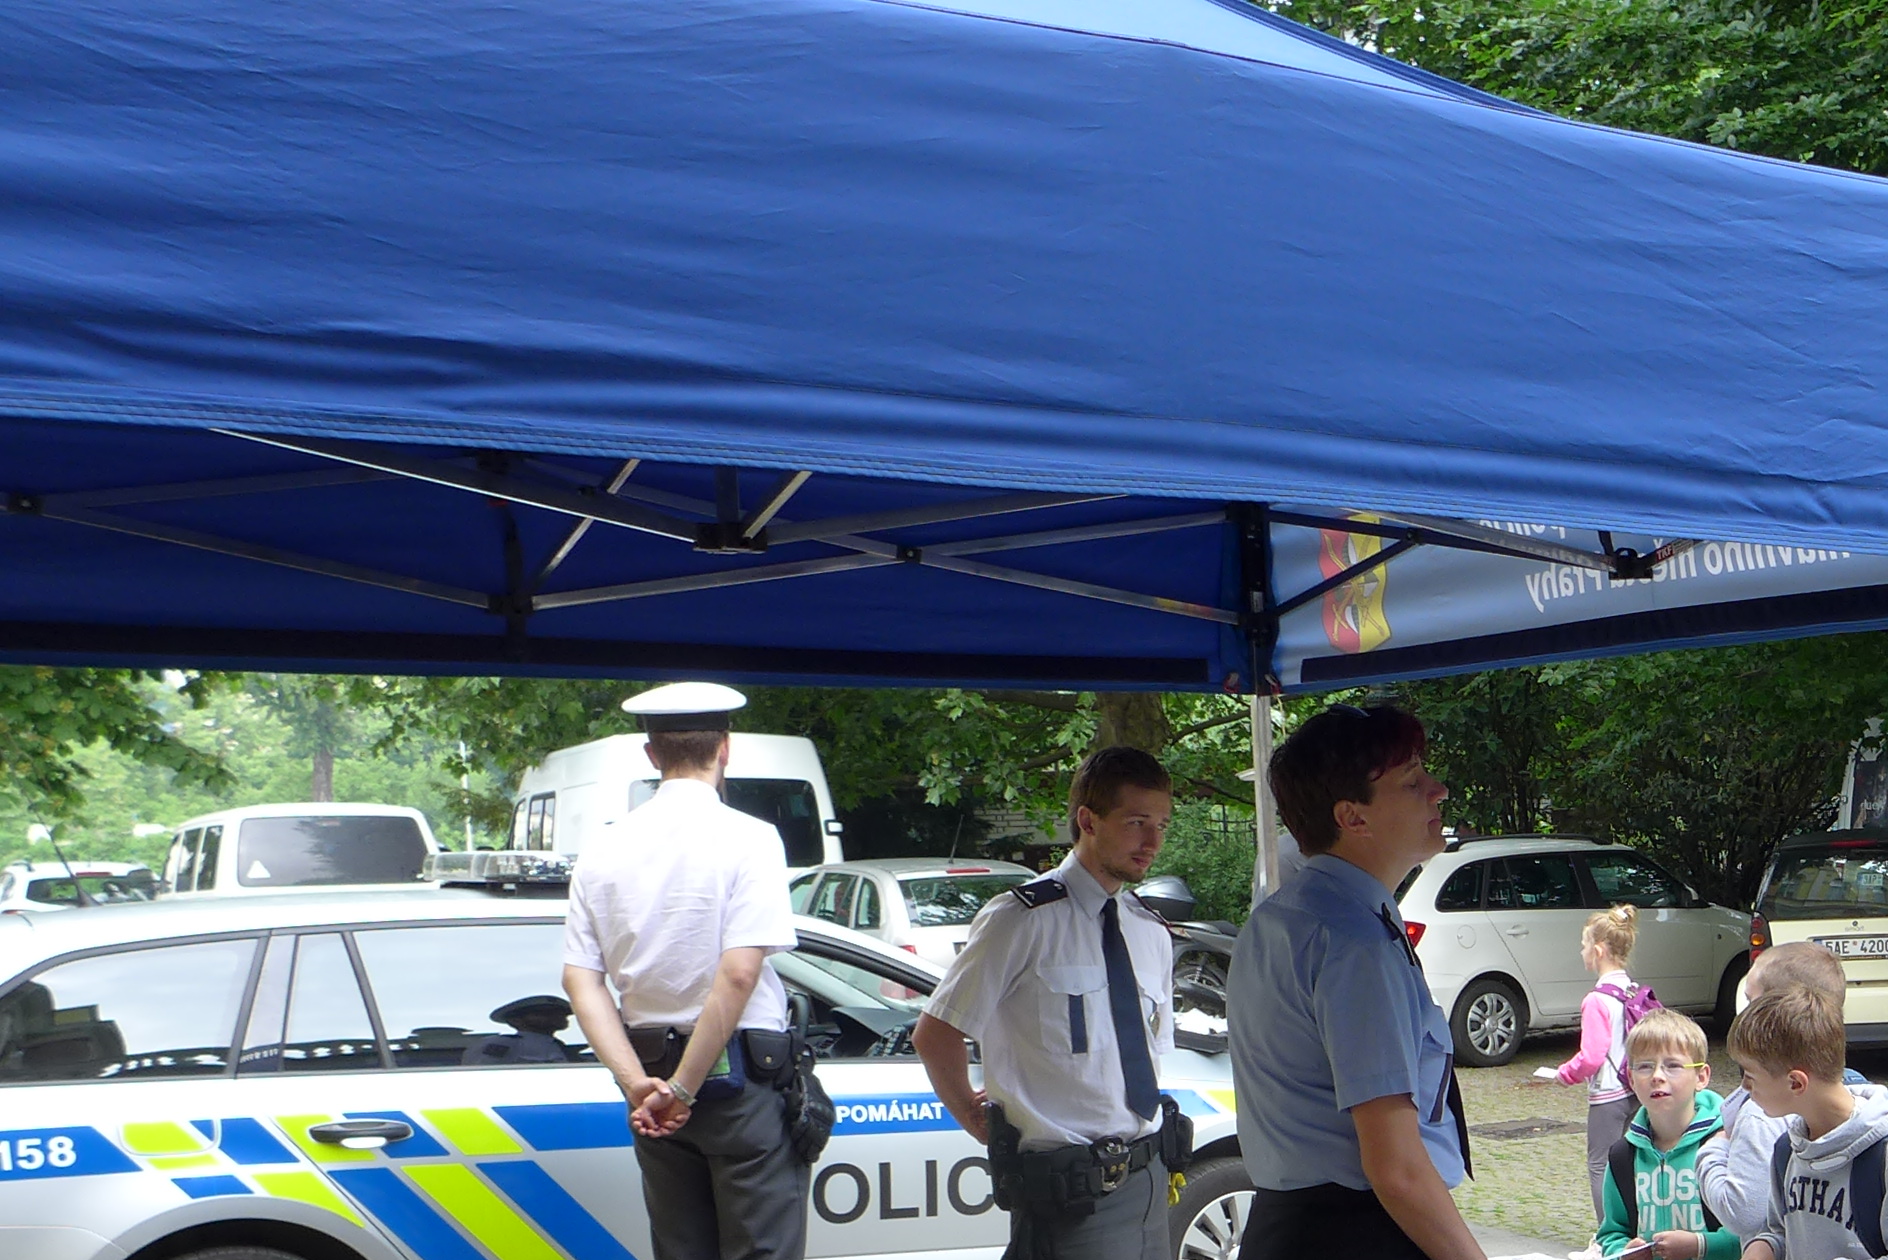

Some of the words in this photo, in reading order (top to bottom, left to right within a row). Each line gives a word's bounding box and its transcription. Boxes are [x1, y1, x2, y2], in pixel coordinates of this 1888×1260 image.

[1656, 545, 1673, 560] TKF
[1825, 941, 1850, 955] 5AE
[836, 1100, 944, 1124] POMÁHAT
[0, 1135, 77, 1171] 158
[813, 1156, 996, 1225] OLIC
[1635, 1165, 1700, 1206] ROS
[1789, 1175, 1857, 1233] STHA
